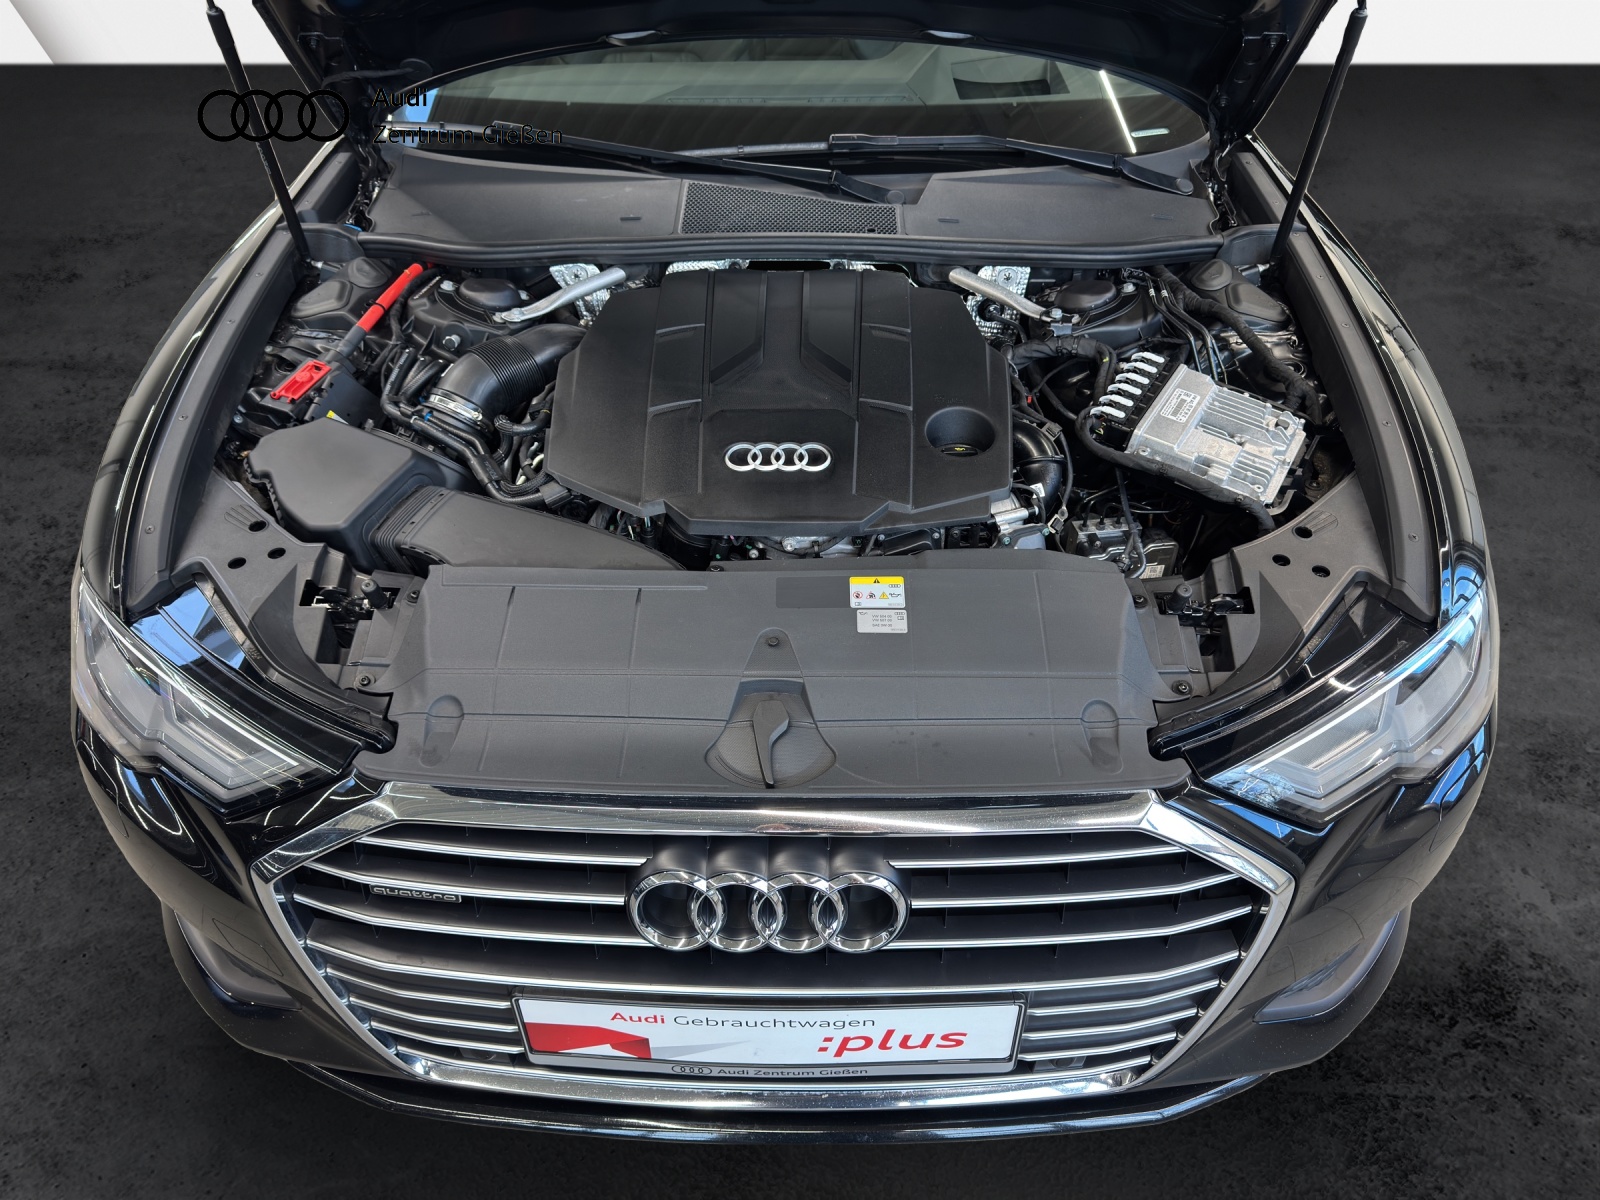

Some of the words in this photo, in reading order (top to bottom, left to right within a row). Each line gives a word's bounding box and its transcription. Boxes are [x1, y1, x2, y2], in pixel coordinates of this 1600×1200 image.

[373, 887, 457, 901] quattro
[610, 1012, 666, 1024] Audi
[673, 1016, 875, 1030] Gebrauchtwagen
[717, 1068, 749, 1076] Audi
[753, 1069, 815, 1077] Zentrum
